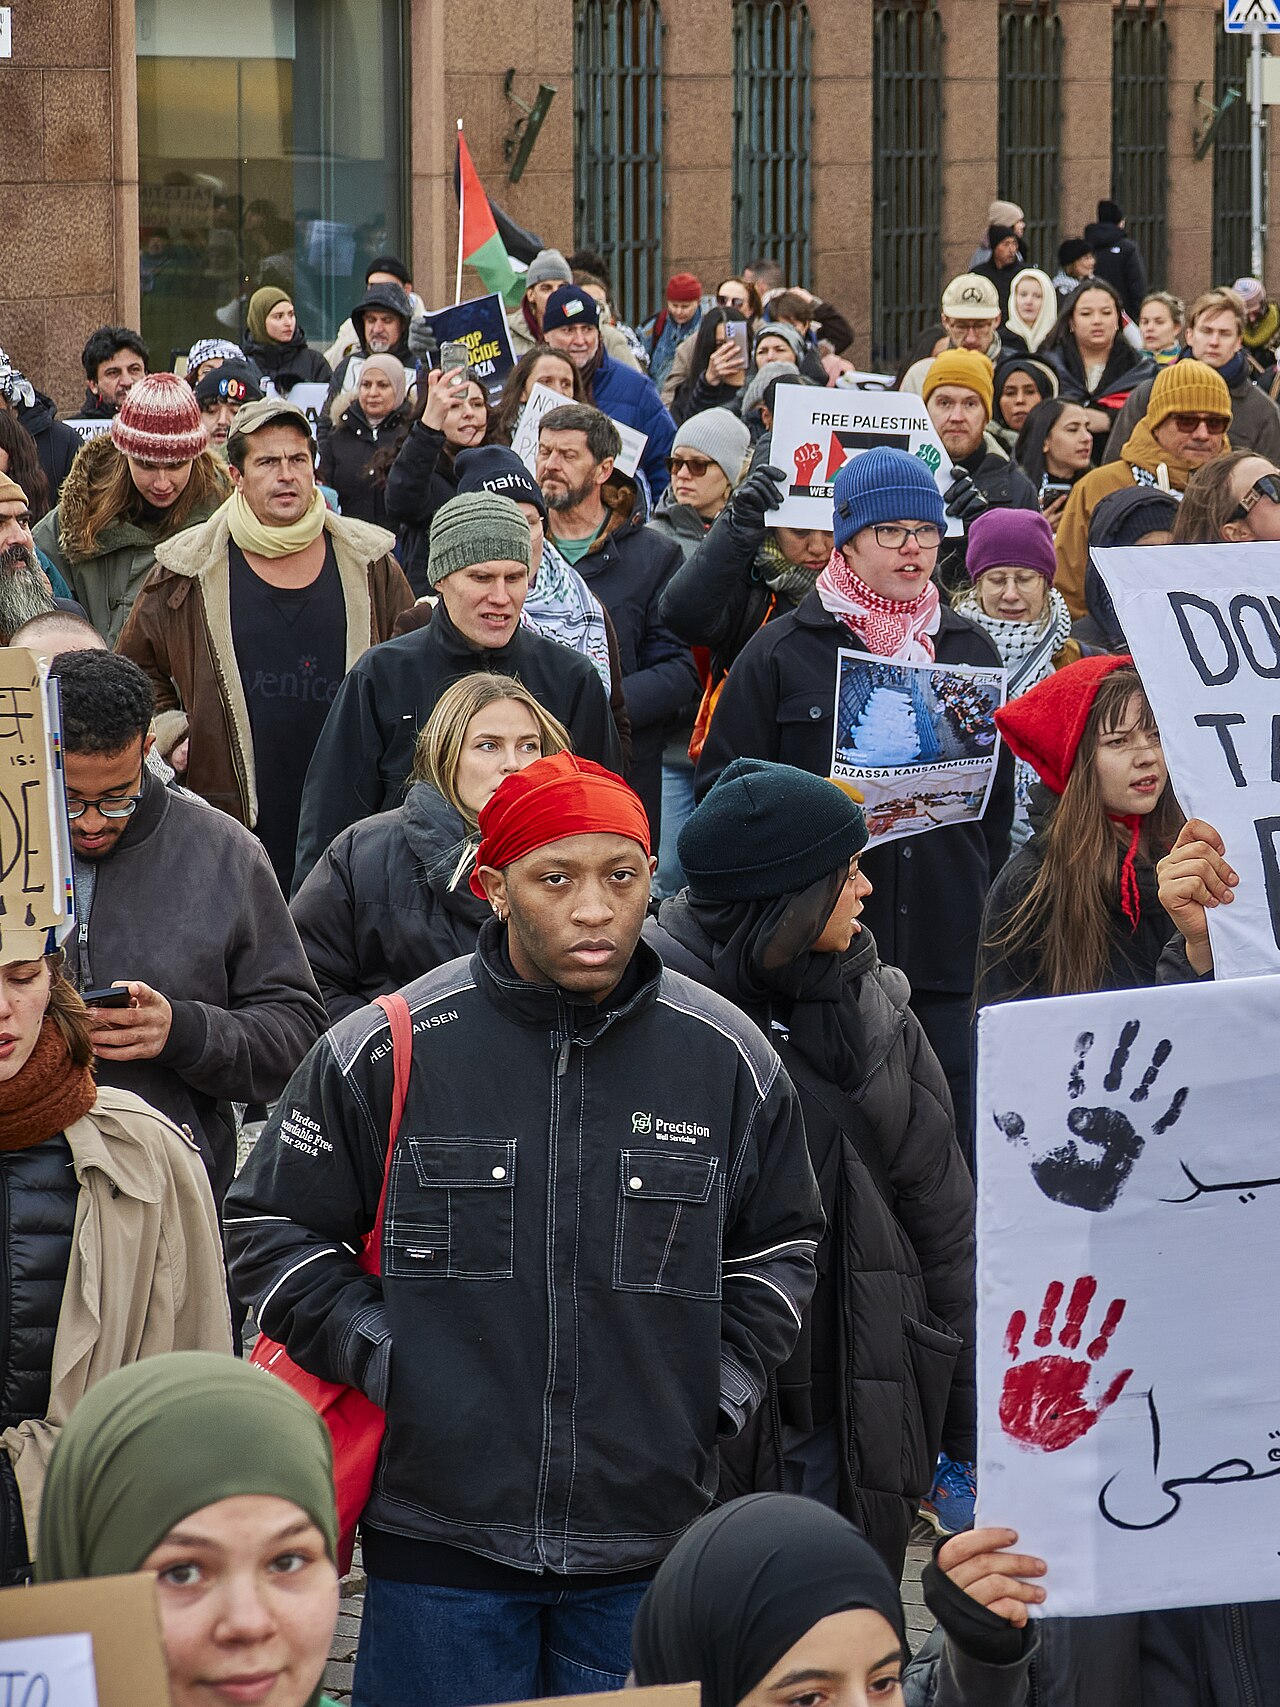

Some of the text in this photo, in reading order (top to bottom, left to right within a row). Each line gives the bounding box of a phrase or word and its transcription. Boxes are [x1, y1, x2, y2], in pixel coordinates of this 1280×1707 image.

[812, 412, 929, 431] FREE PALESTINE
[809, 486, 826, 498] WE
[833, 757, 993, 779] GAZASSA KANSANMURHA
[412, 1010, 459, 1035] ANSEN
[291, 1108, 321, 1133] Virden
[655, 1118, 710, 1138] Precision
[293, 1139, 319, 1157] 2014
[312, 1134, 334, 1152] Free
[656, 1132, 697, 1145] Well Servicing
